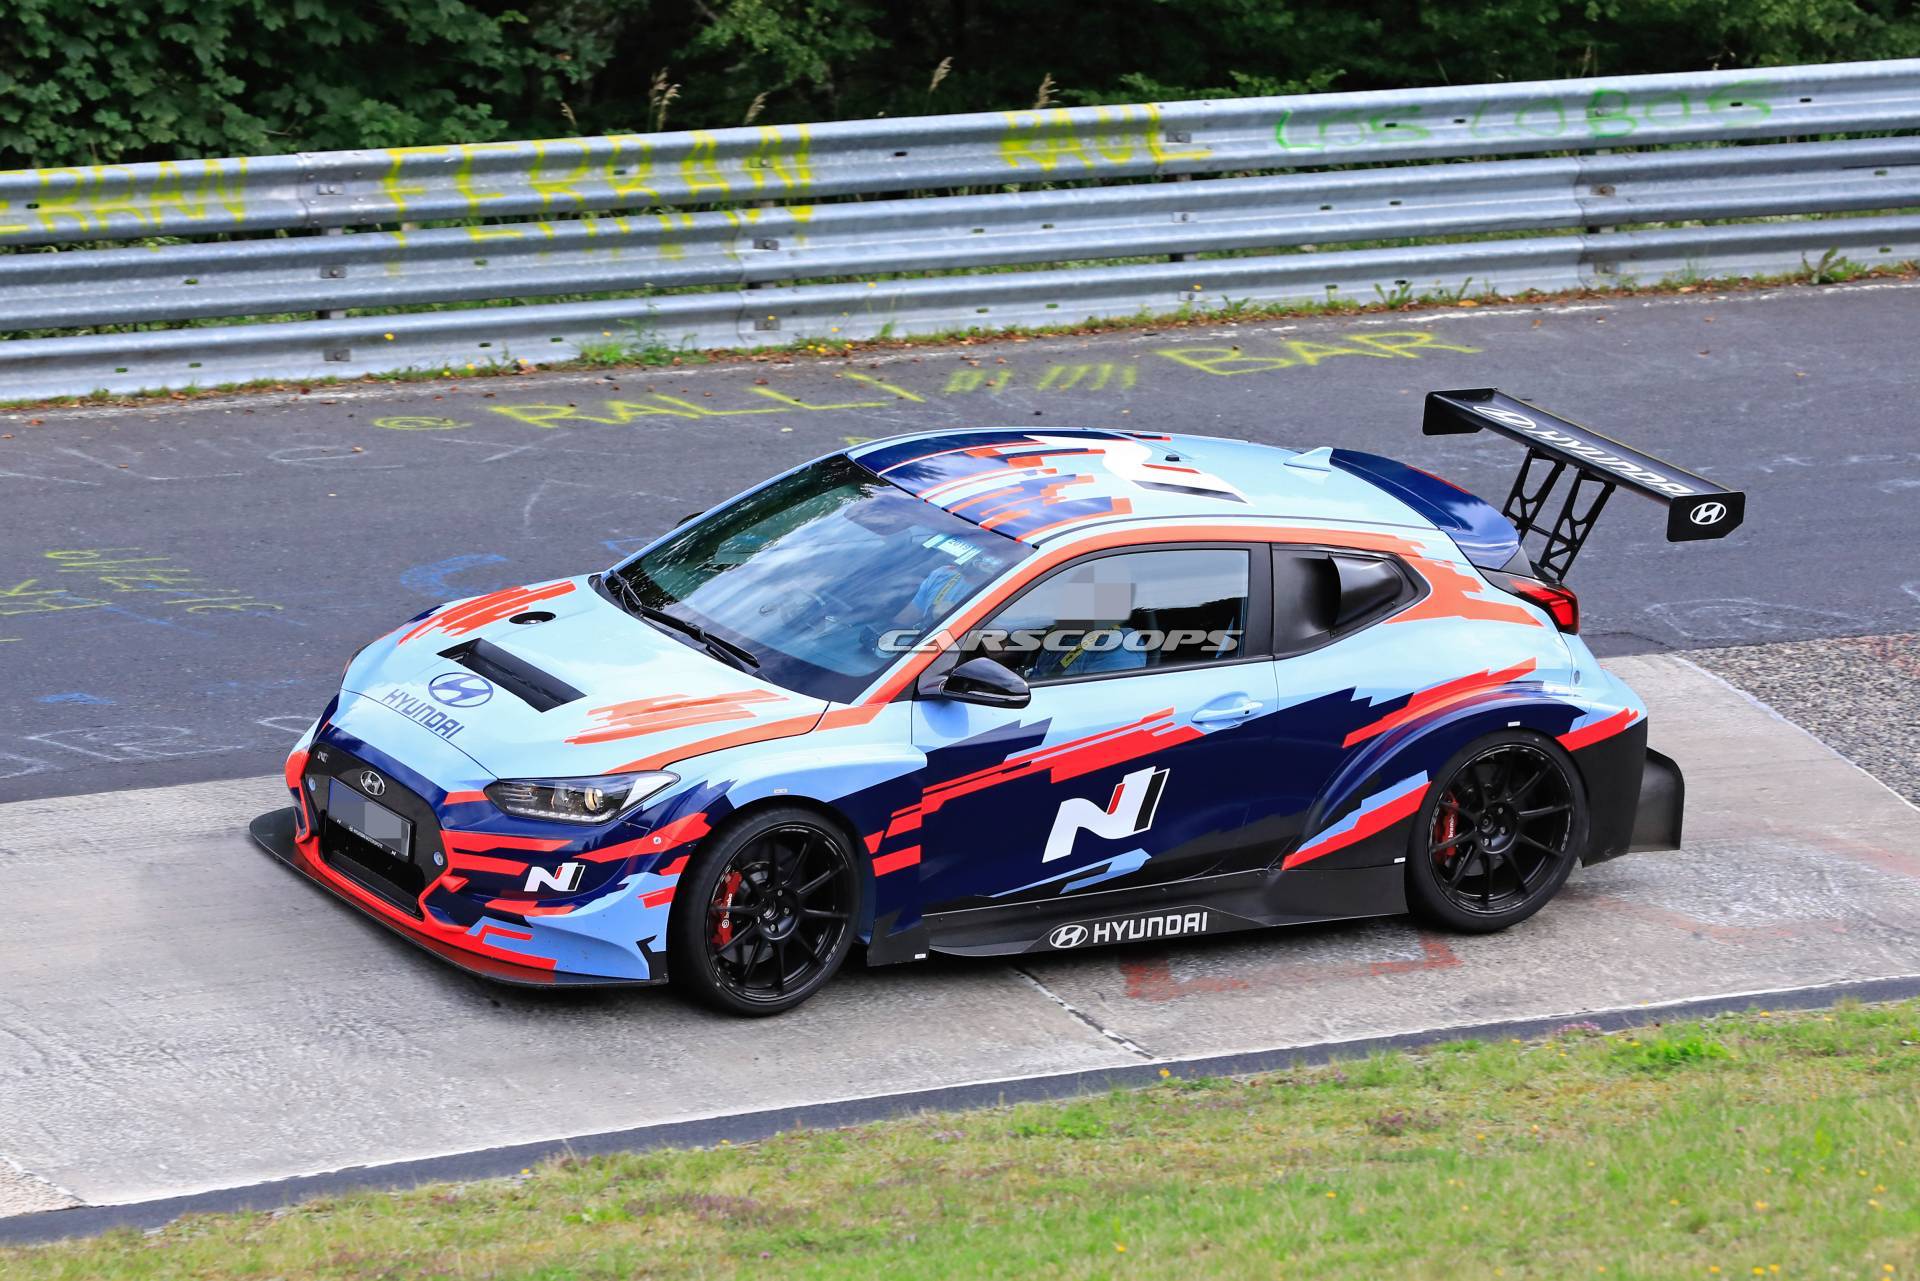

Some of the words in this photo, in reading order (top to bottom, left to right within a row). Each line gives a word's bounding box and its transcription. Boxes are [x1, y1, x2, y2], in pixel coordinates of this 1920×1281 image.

[999, 102, 1212, 171] RAUL
[1275, 104, 1430, 150] LOS
[1157, 331, 1484, 376] BAR
[381, 688, 465, 740] HYUNDAI
[1093, 911, 1208, 943] HYUNDAI
